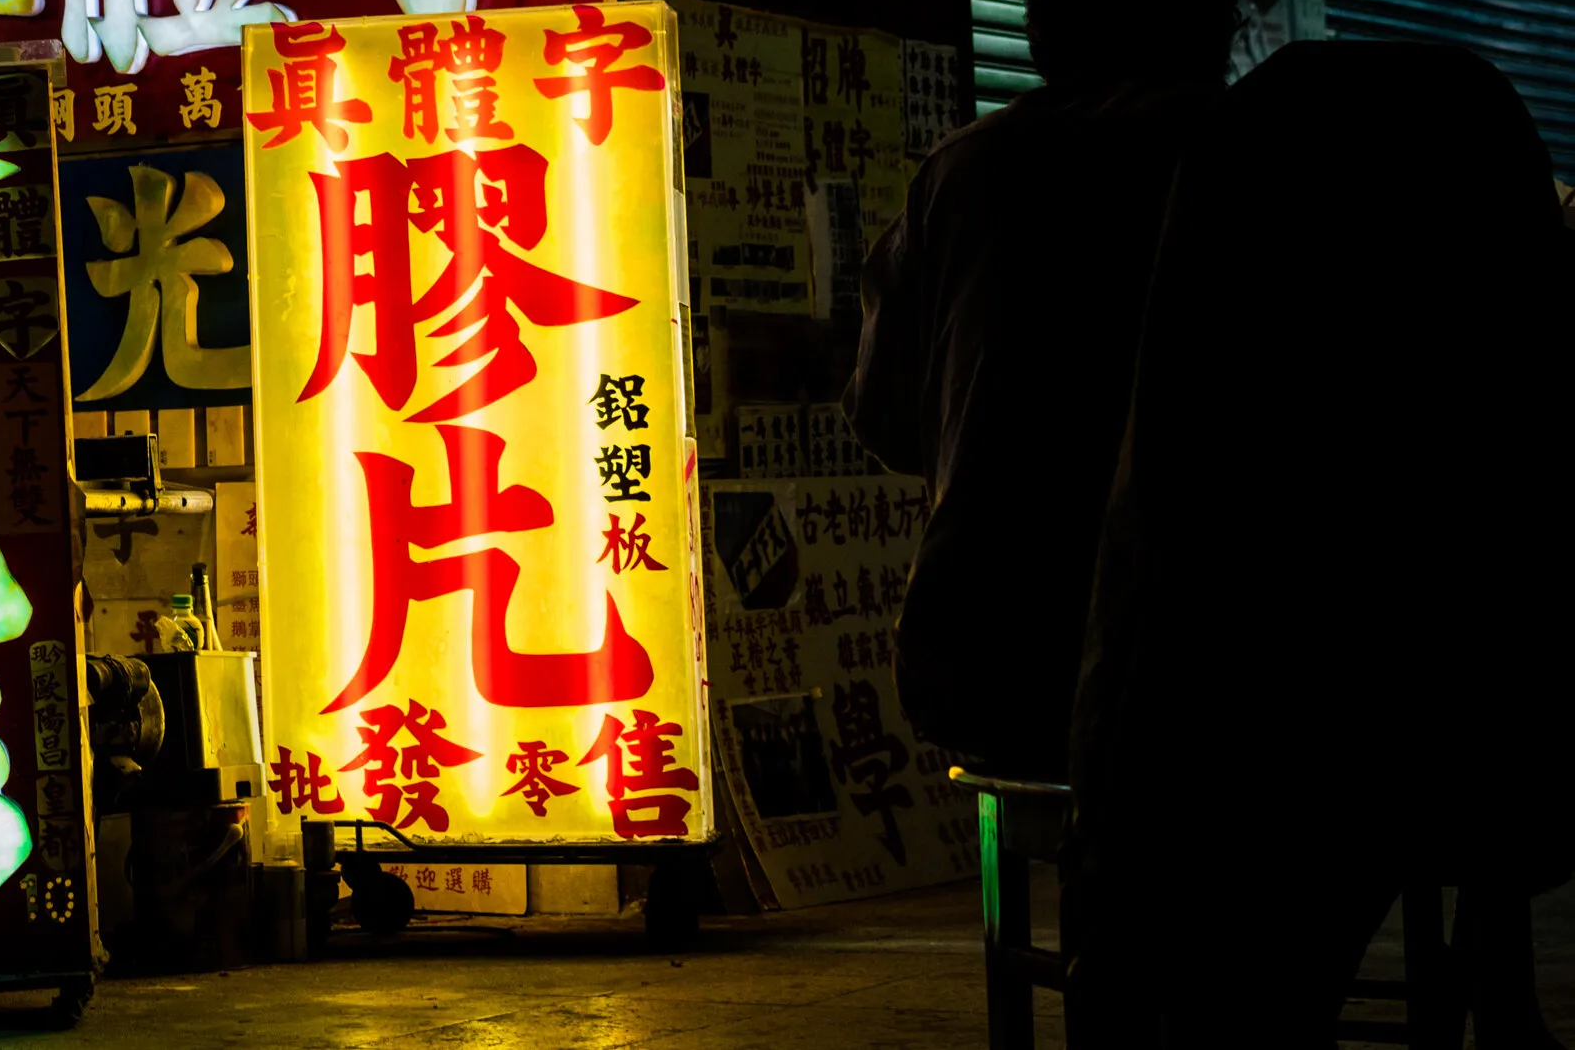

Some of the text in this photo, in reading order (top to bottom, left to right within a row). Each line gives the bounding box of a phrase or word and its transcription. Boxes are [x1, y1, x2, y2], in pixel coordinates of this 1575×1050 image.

[295, 143, 655, 716] 膠片
[588, 373, 668, 574] 鋁塑板
[267, 698, 701, 842] 批發零售
[829, 678, 915, 869] 學
